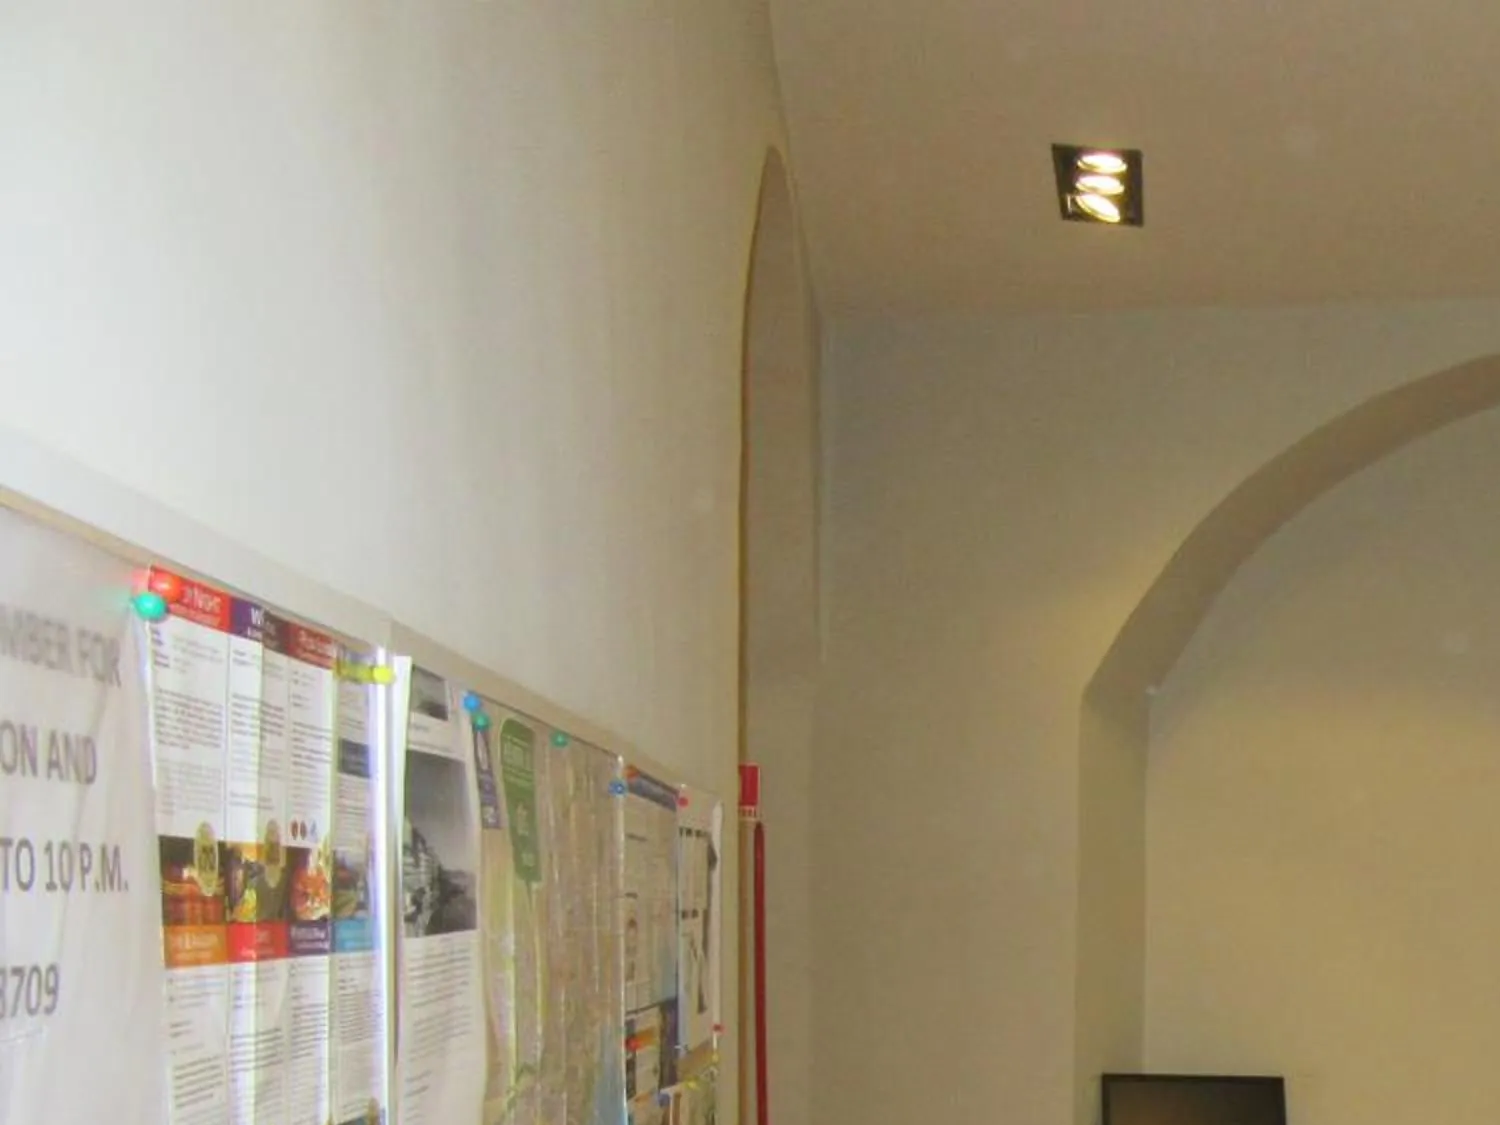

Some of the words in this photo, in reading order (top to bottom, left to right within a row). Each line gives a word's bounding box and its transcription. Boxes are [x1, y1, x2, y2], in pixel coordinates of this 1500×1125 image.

[76, 626, 121, 688] FOR
[0, 719, 38, 778] ON
[46, 728, 97, 785] AND
[0, 836, 34, 892] TO
[43, 839, 74, 893] 10
[79, 841, 128, 893] P.M.
